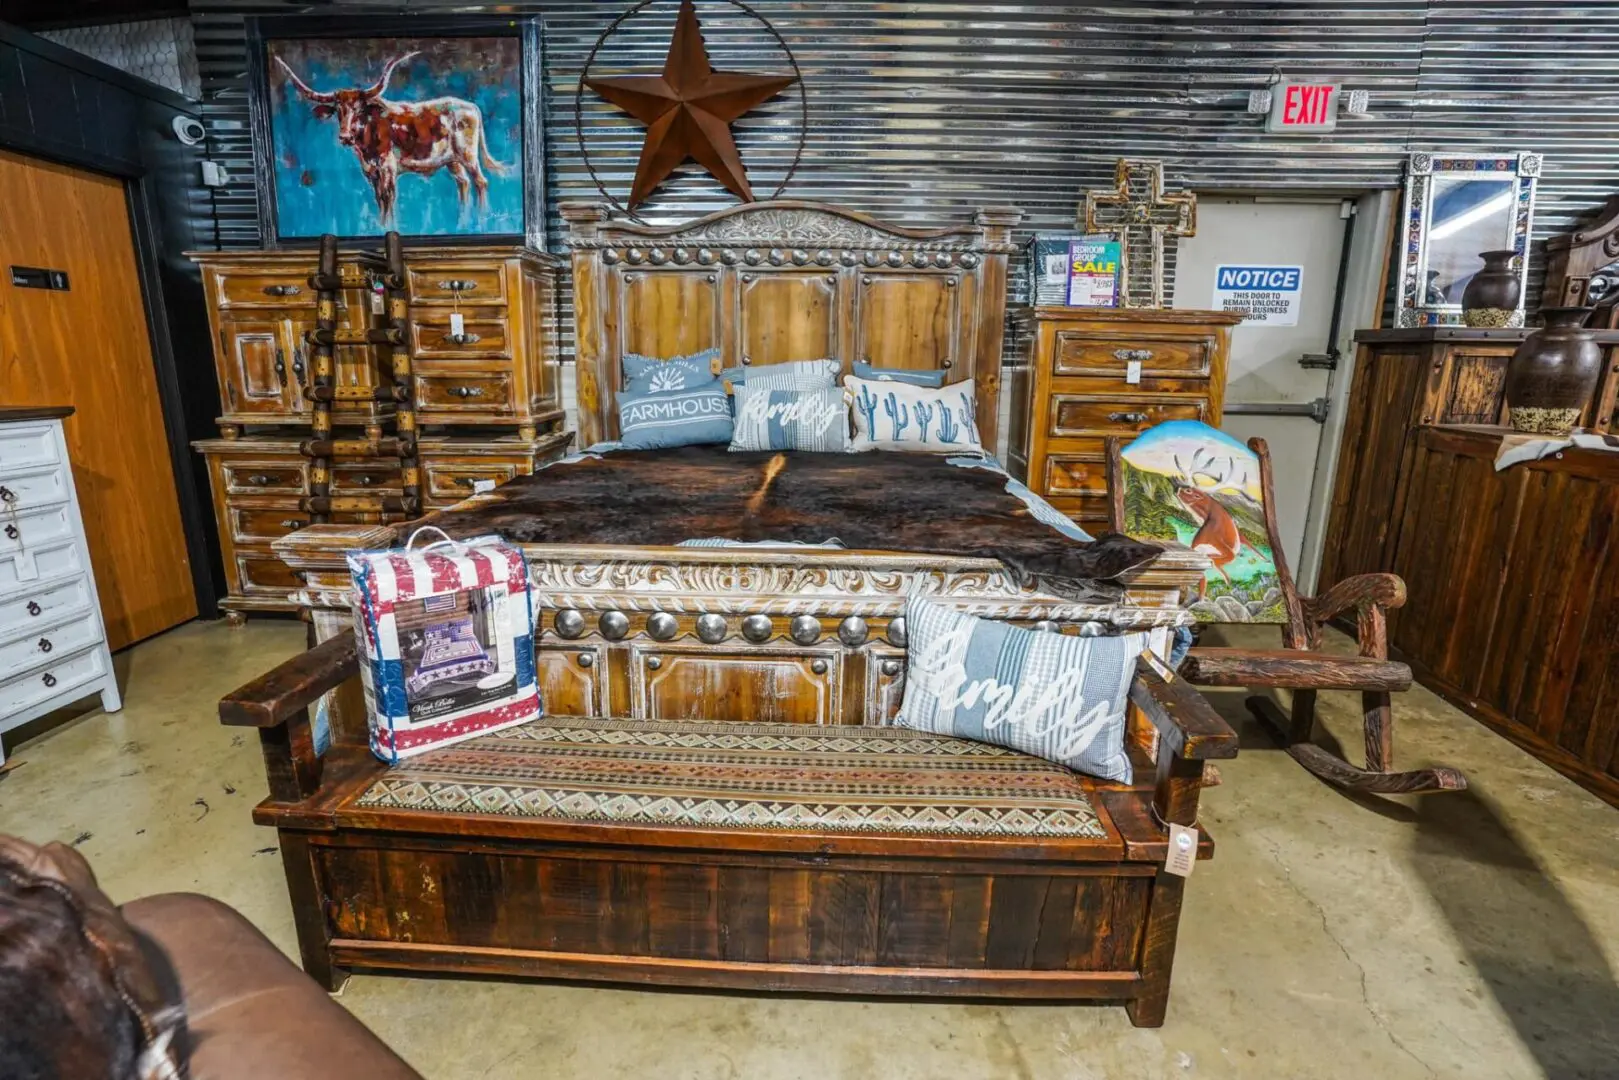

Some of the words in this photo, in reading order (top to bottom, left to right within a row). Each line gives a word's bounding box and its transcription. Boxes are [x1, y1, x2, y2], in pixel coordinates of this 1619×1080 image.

[1282, 85, 1334, 125] EXIT
[1072, 245, 1106, 254] BEDROOM
[1072, 253, 1096, 262] GROUP
[1072, 261, 1116, 273] SALE
[1220, 269, 1298, 288] NOTICE
[1252, 299, 1290, 307] UNLOCKED
[1252, 306, 1288, 314] BUSINESS
[621, 397, 731, 426] FARMHOUSE
[735, 388, 844, 443] family
[909, 629, 1126, 761] family
